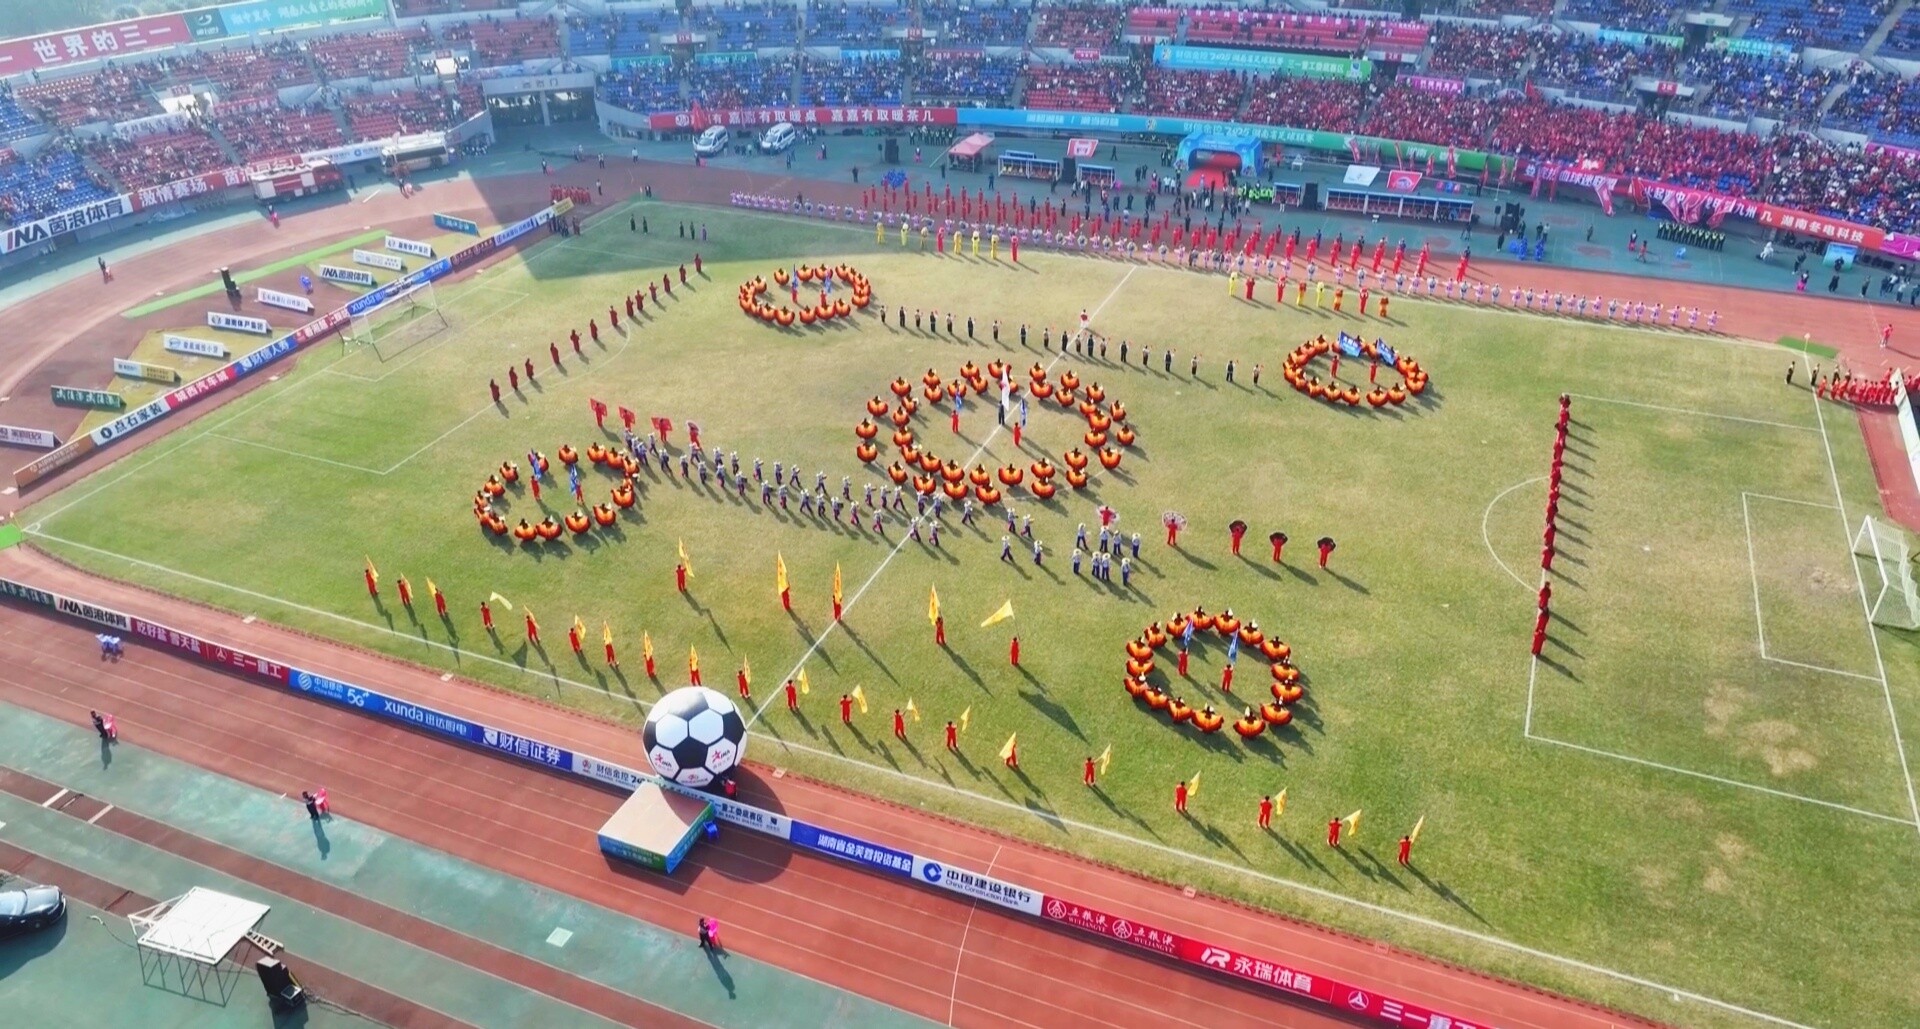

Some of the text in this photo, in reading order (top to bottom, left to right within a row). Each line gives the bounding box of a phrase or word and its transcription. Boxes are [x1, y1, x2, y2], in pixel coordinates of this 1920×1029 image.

[33, 25, 171, 63] 世界的三一
[114, 402, 162, 433] 点石家装
[233, 651, 282, 679] 三一重工
[314, 677, 343, 693] 中国移动
[384, 699, 423, 723] xunda
[499, 731, 561, 766] 财信证券
[596, 764, 629, 783] 财信金控
[945, 879, 1019, 907] China Construction Bank
[946, 869, 1031, 904] 中国建设银行
[1068, 917, 1106, 932] WULIANGYE
[1134, 936, 1173, 953] WULIANGYE
[1234, 956, 1312, 994] 永瑞体育
